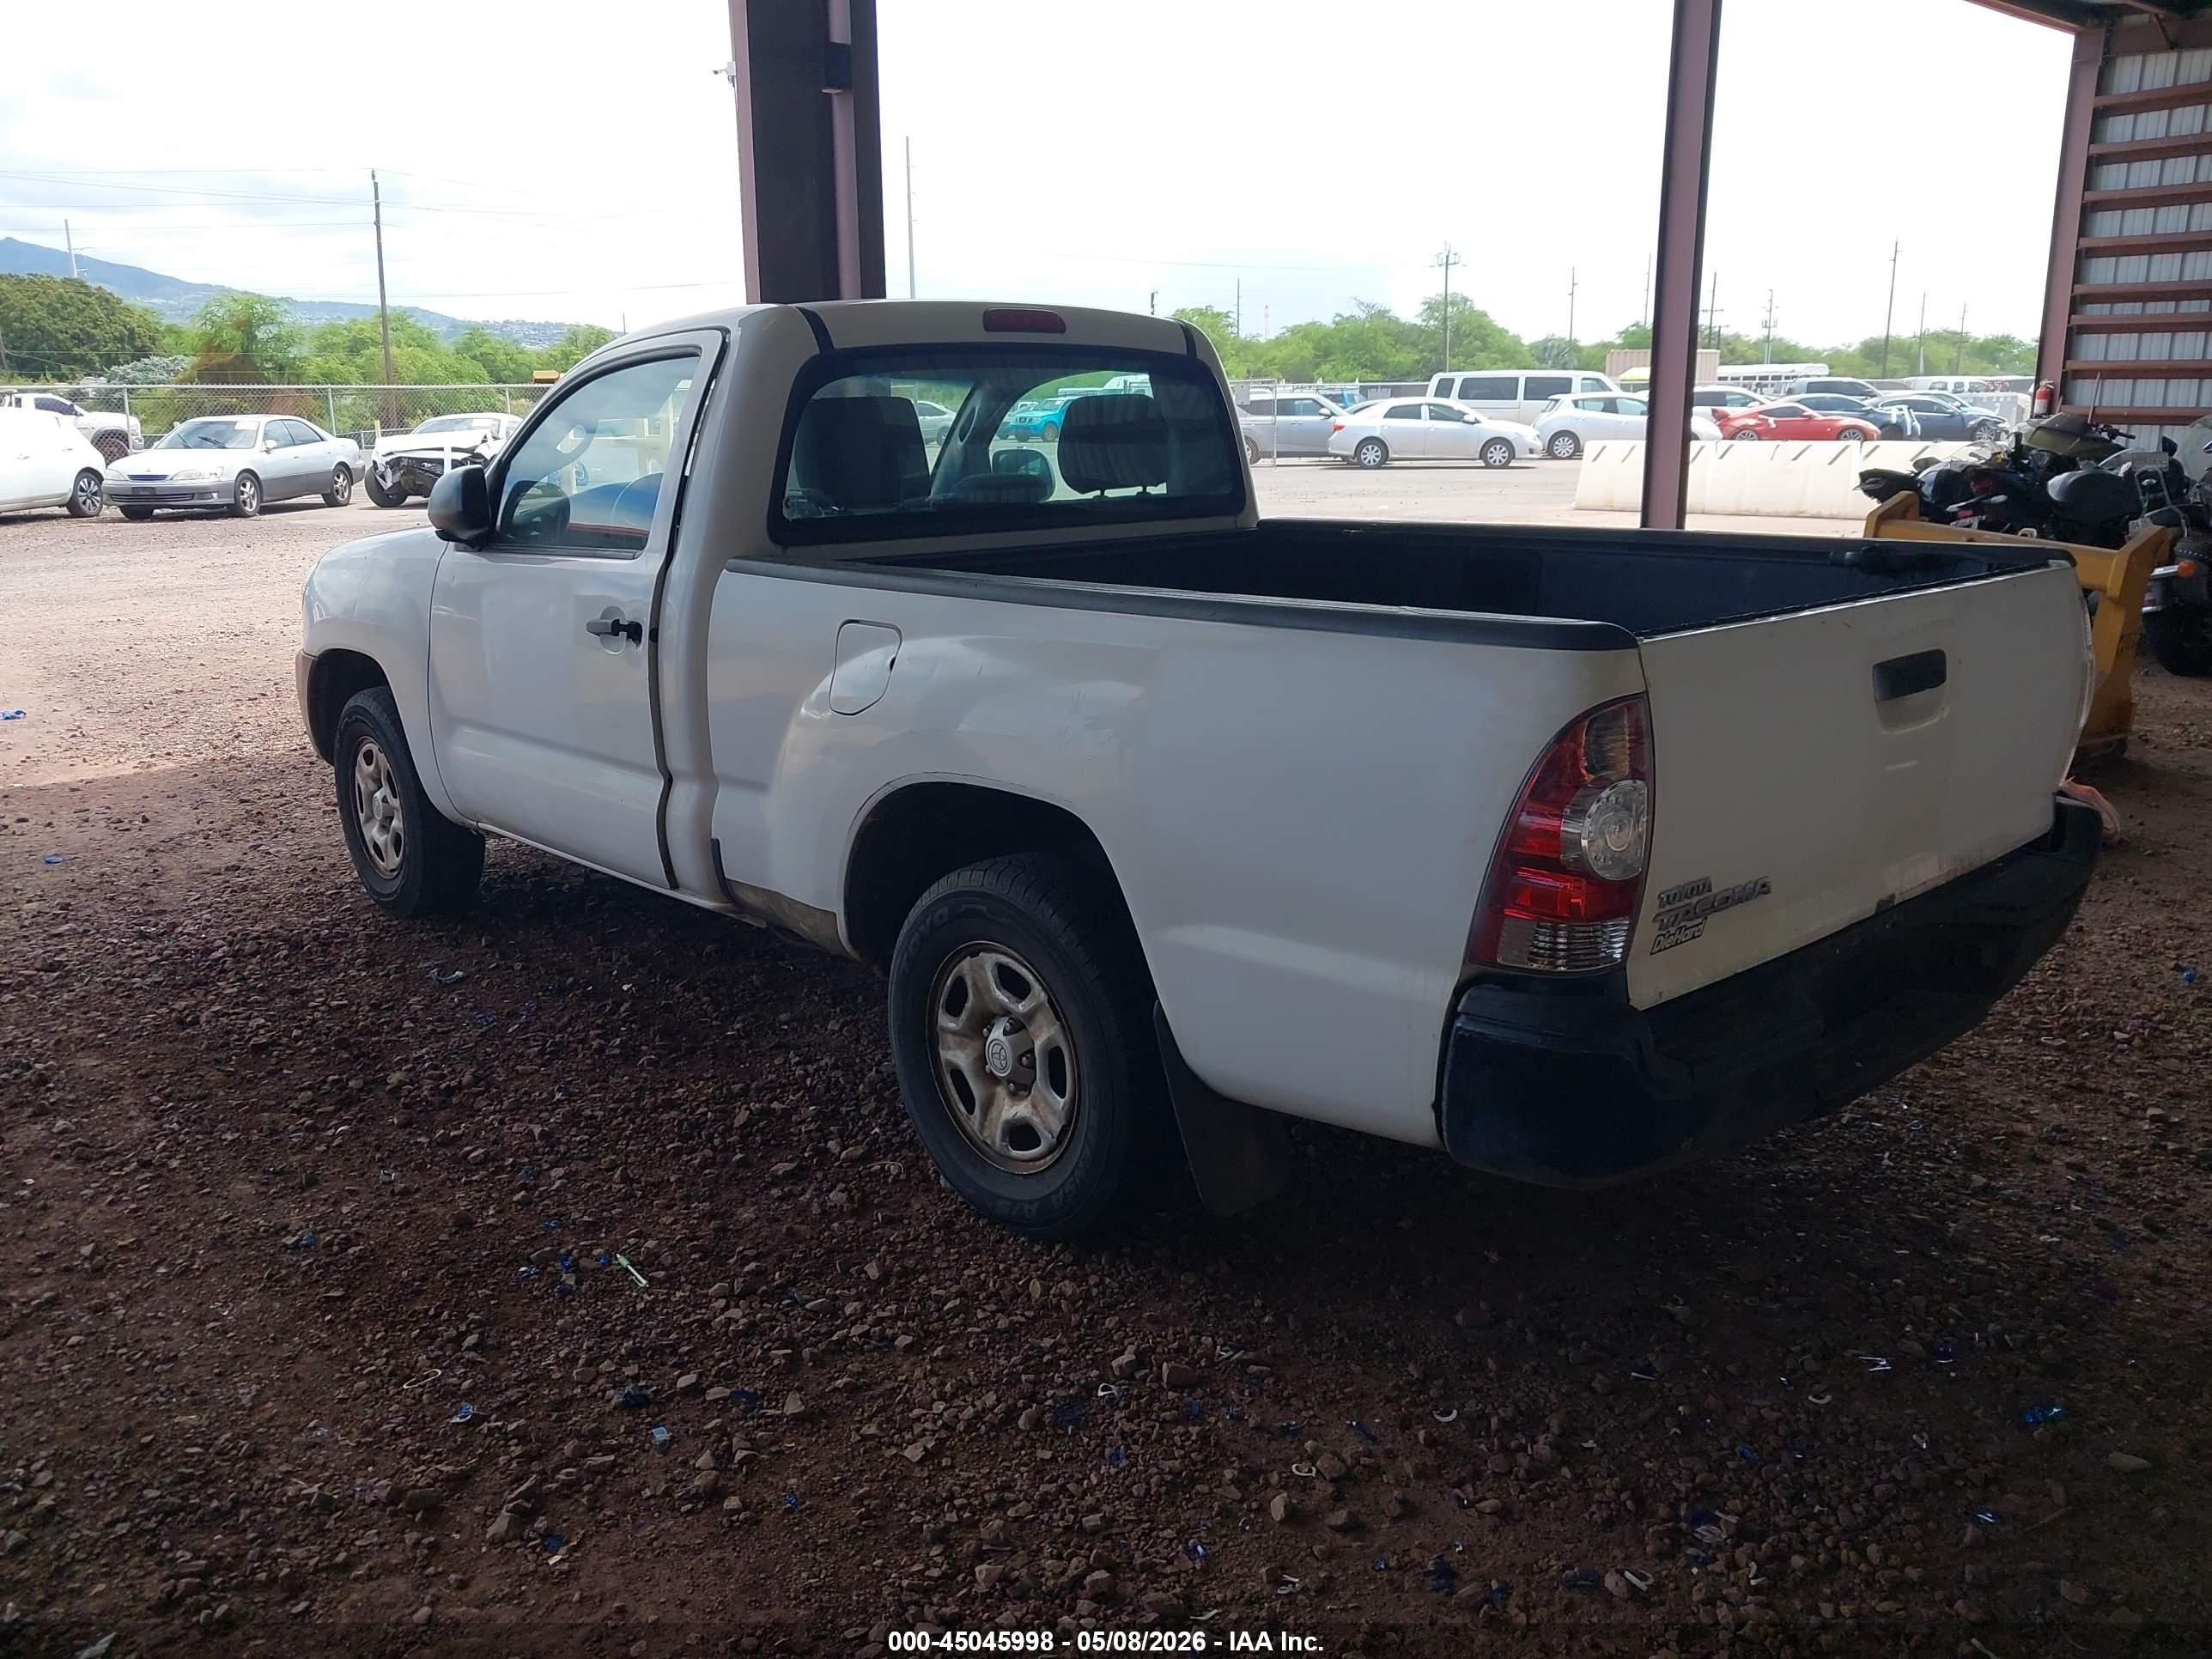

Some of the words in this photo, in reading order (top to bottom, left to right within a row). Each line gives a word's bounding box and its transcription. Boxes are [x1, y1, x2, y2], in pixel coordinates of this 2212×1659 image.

[1653, 876, 1771, 931] TACOMA
[1658, 877, 1712, 908] TOYOTA
[1650, 918, 1707, 955] DieHard
